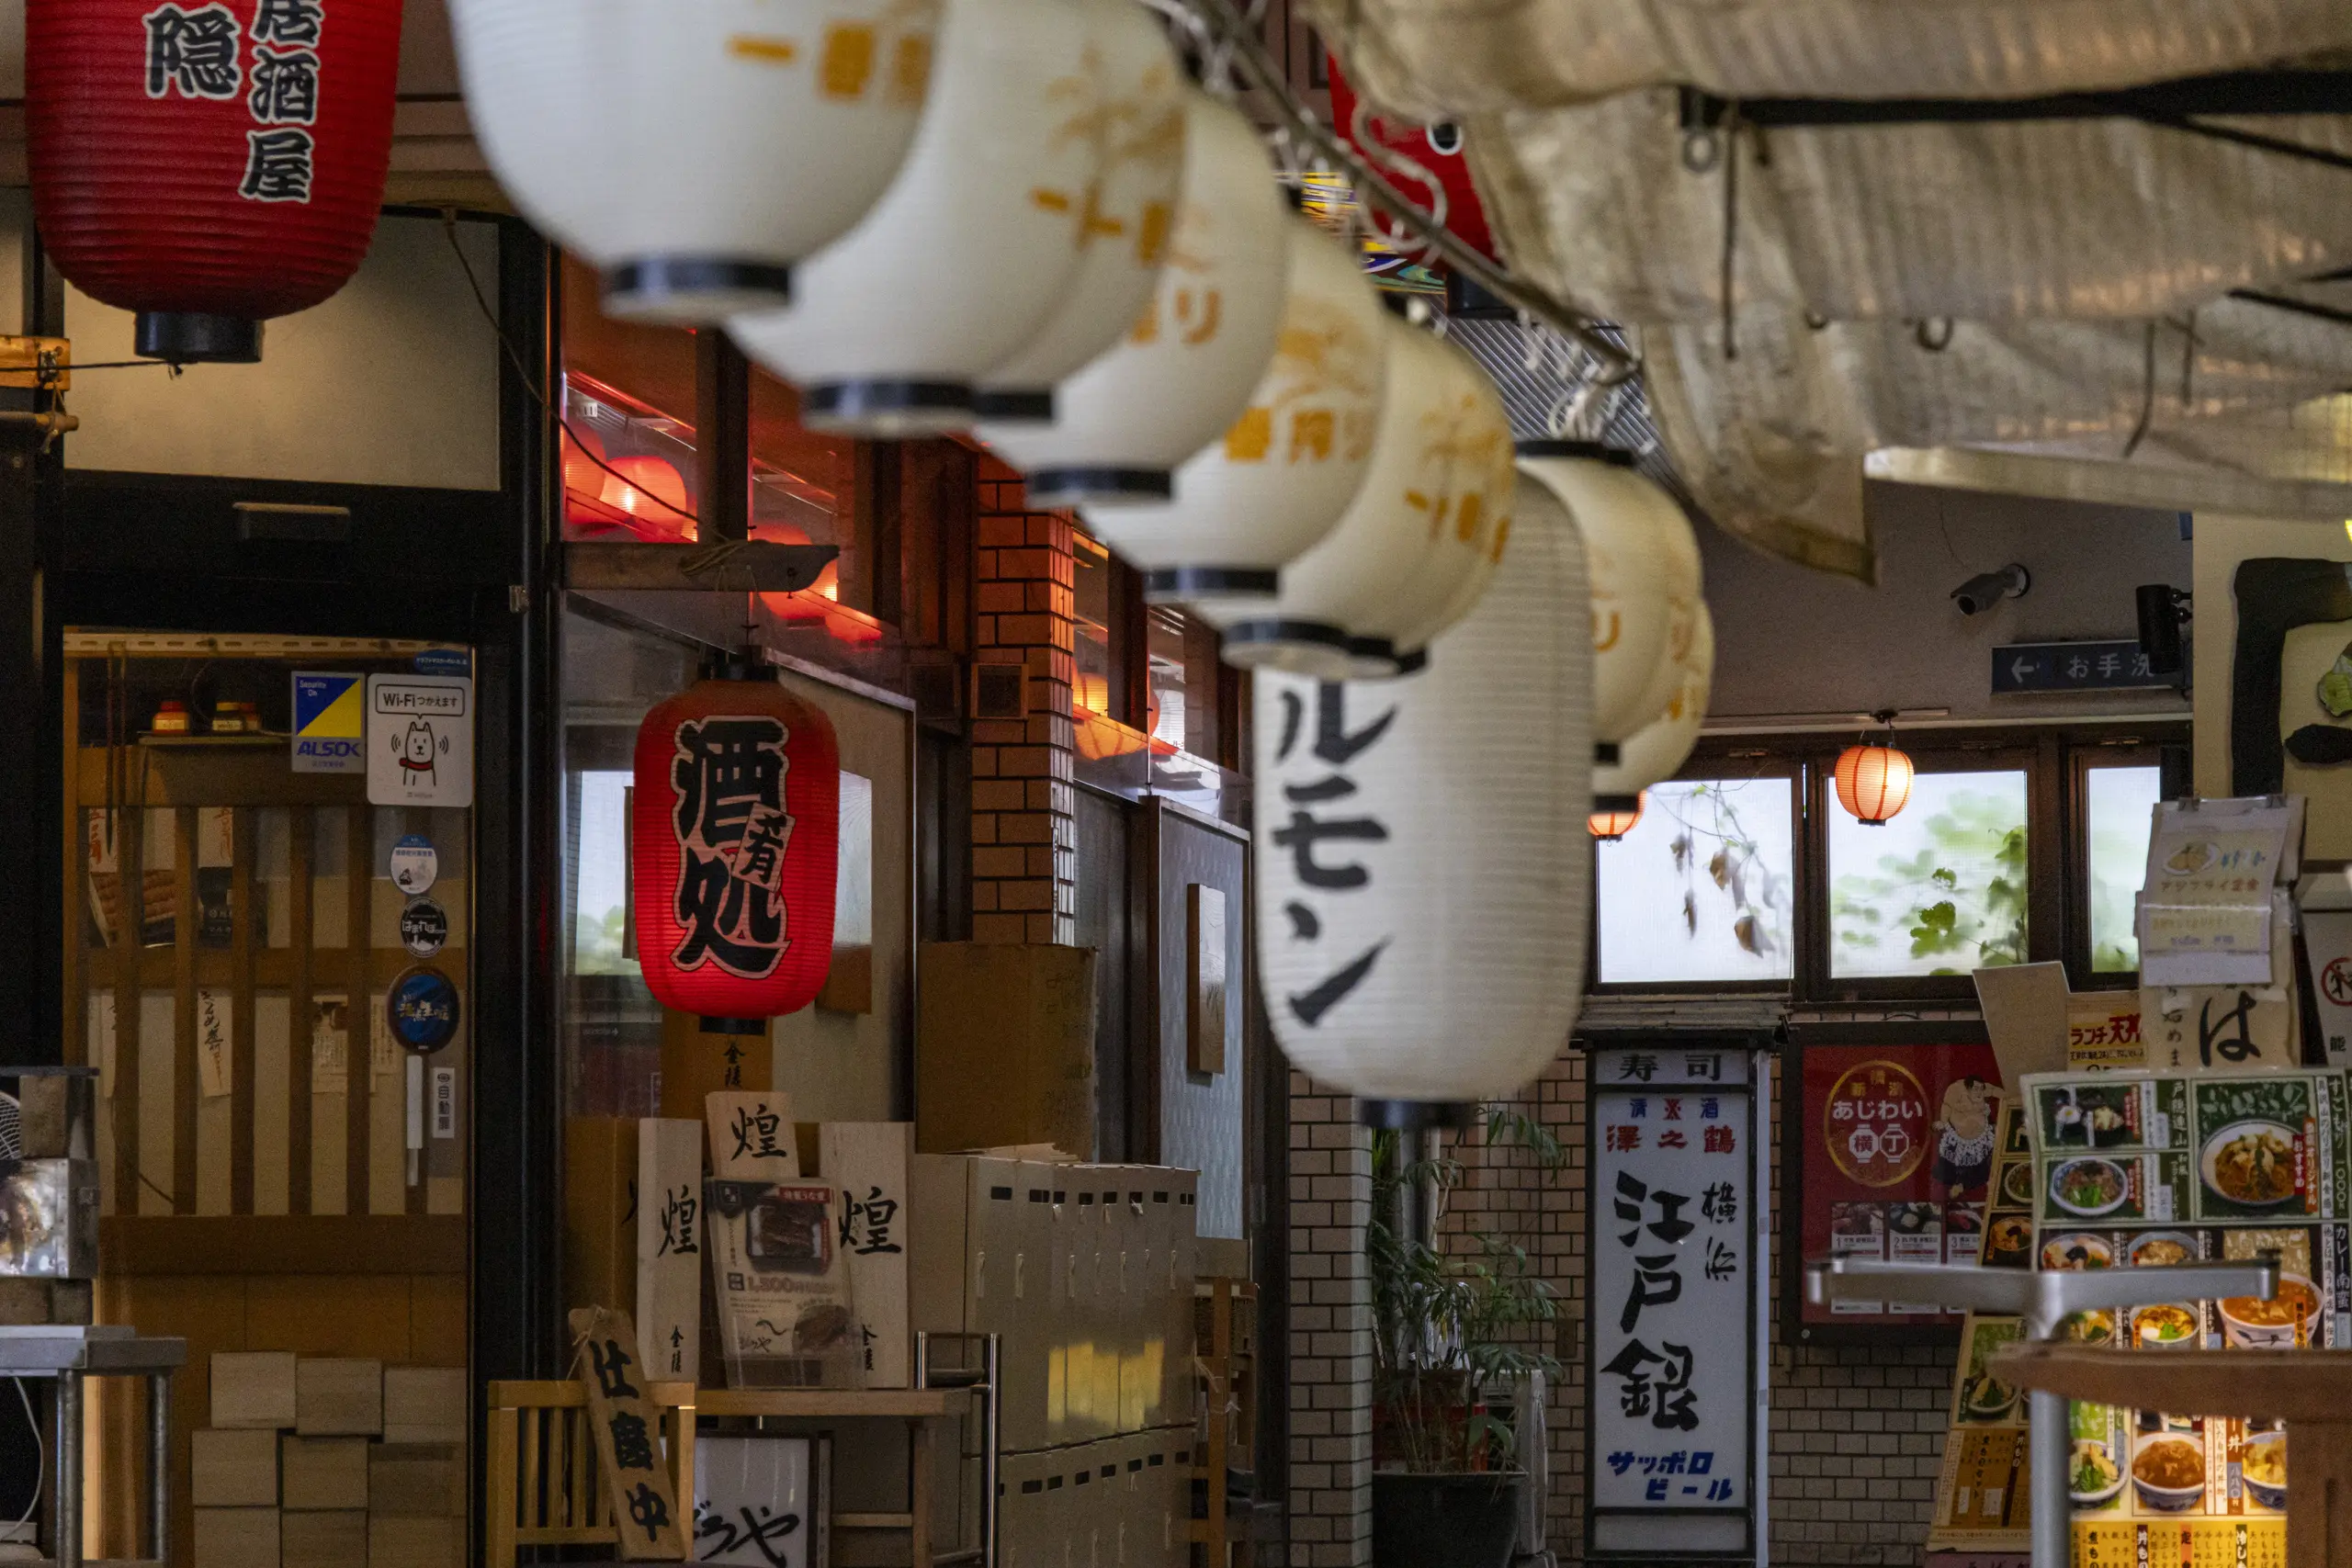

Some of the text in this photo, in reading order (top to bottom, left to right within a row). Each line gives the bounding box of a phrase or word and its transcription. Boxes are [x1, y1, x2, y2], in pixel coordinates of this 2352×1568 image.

[239, 0, 324, 203] 居酒屋
[307, 689, 318, 697] On
[297, 741, 361, 757] ALSOK
[1619, 1054, 1723, 1082] 寿司
[1832, 1100, 1923, 1121] あじわい
[2294, 1139, 2304, 1188] おすすめ
[1702, 1181, 1738, 1282] 横浜
[1600, 1170, 1701, 1432] 江戸銀
[1607, 1450, 1714, 1476] サッポロ
[1645, 1478, 1735, 1503] ビール
